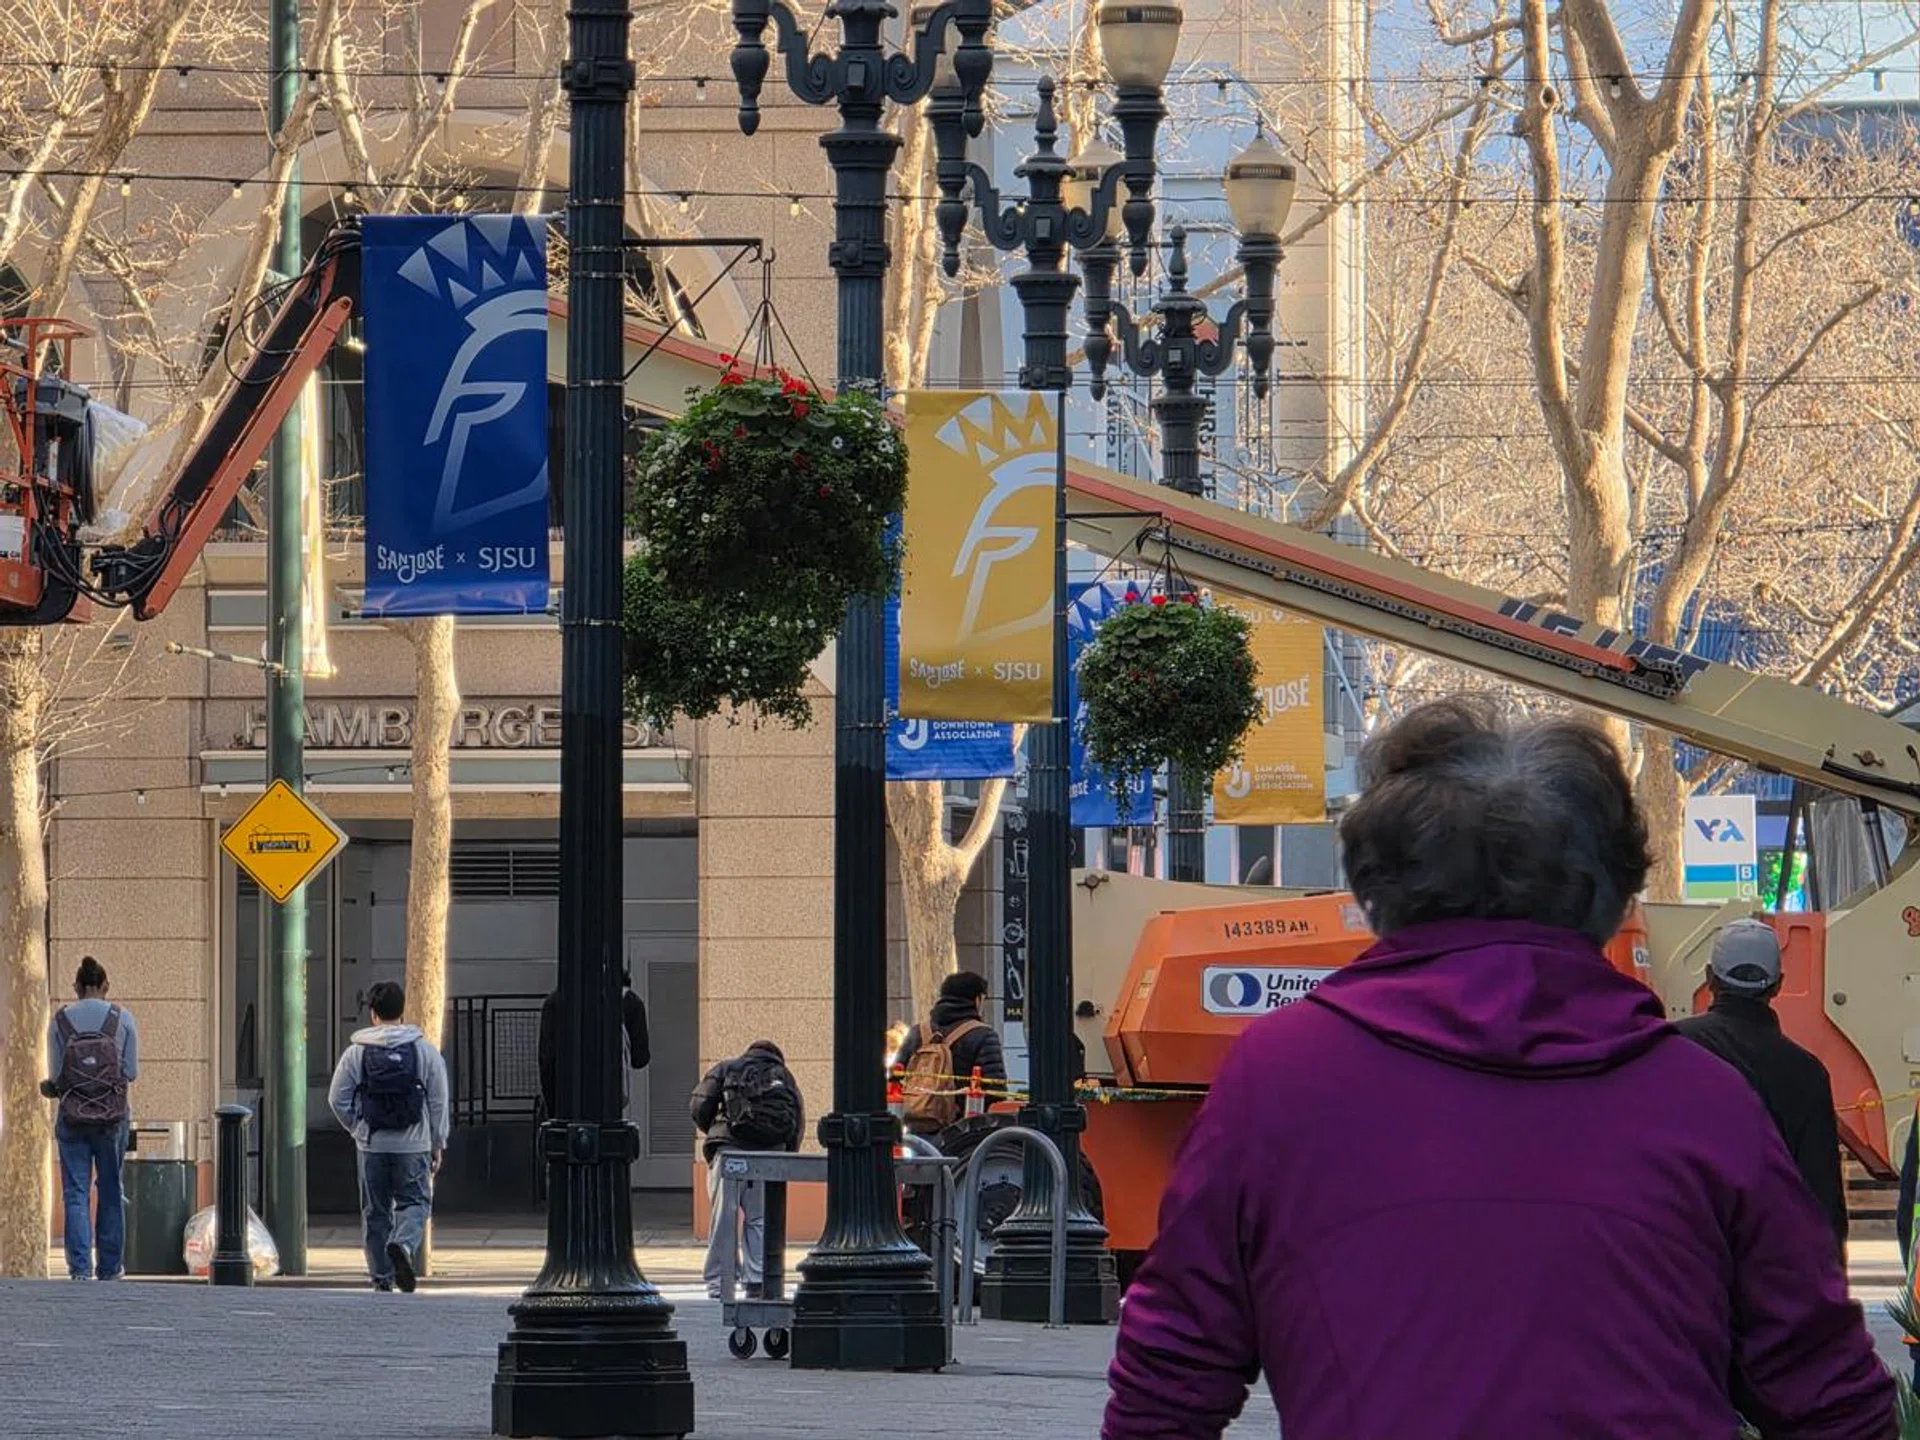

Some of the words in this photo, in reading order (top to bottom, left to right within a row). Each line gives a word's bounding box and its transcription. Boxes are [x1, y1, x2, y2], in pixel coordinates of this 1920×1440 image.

[478, 547, 536, 573] SJSU
[994, 662, 1042, 682] SJSU
[242, 703, 648, 747] HAMBRGE
[932, 721, 994, 731] DOWNTOWN
[934, 730, 1001, 740] ASSOCIATION
[1741, 866, 1752, 879] B
[1266, 973, 1320, 992] Unite
